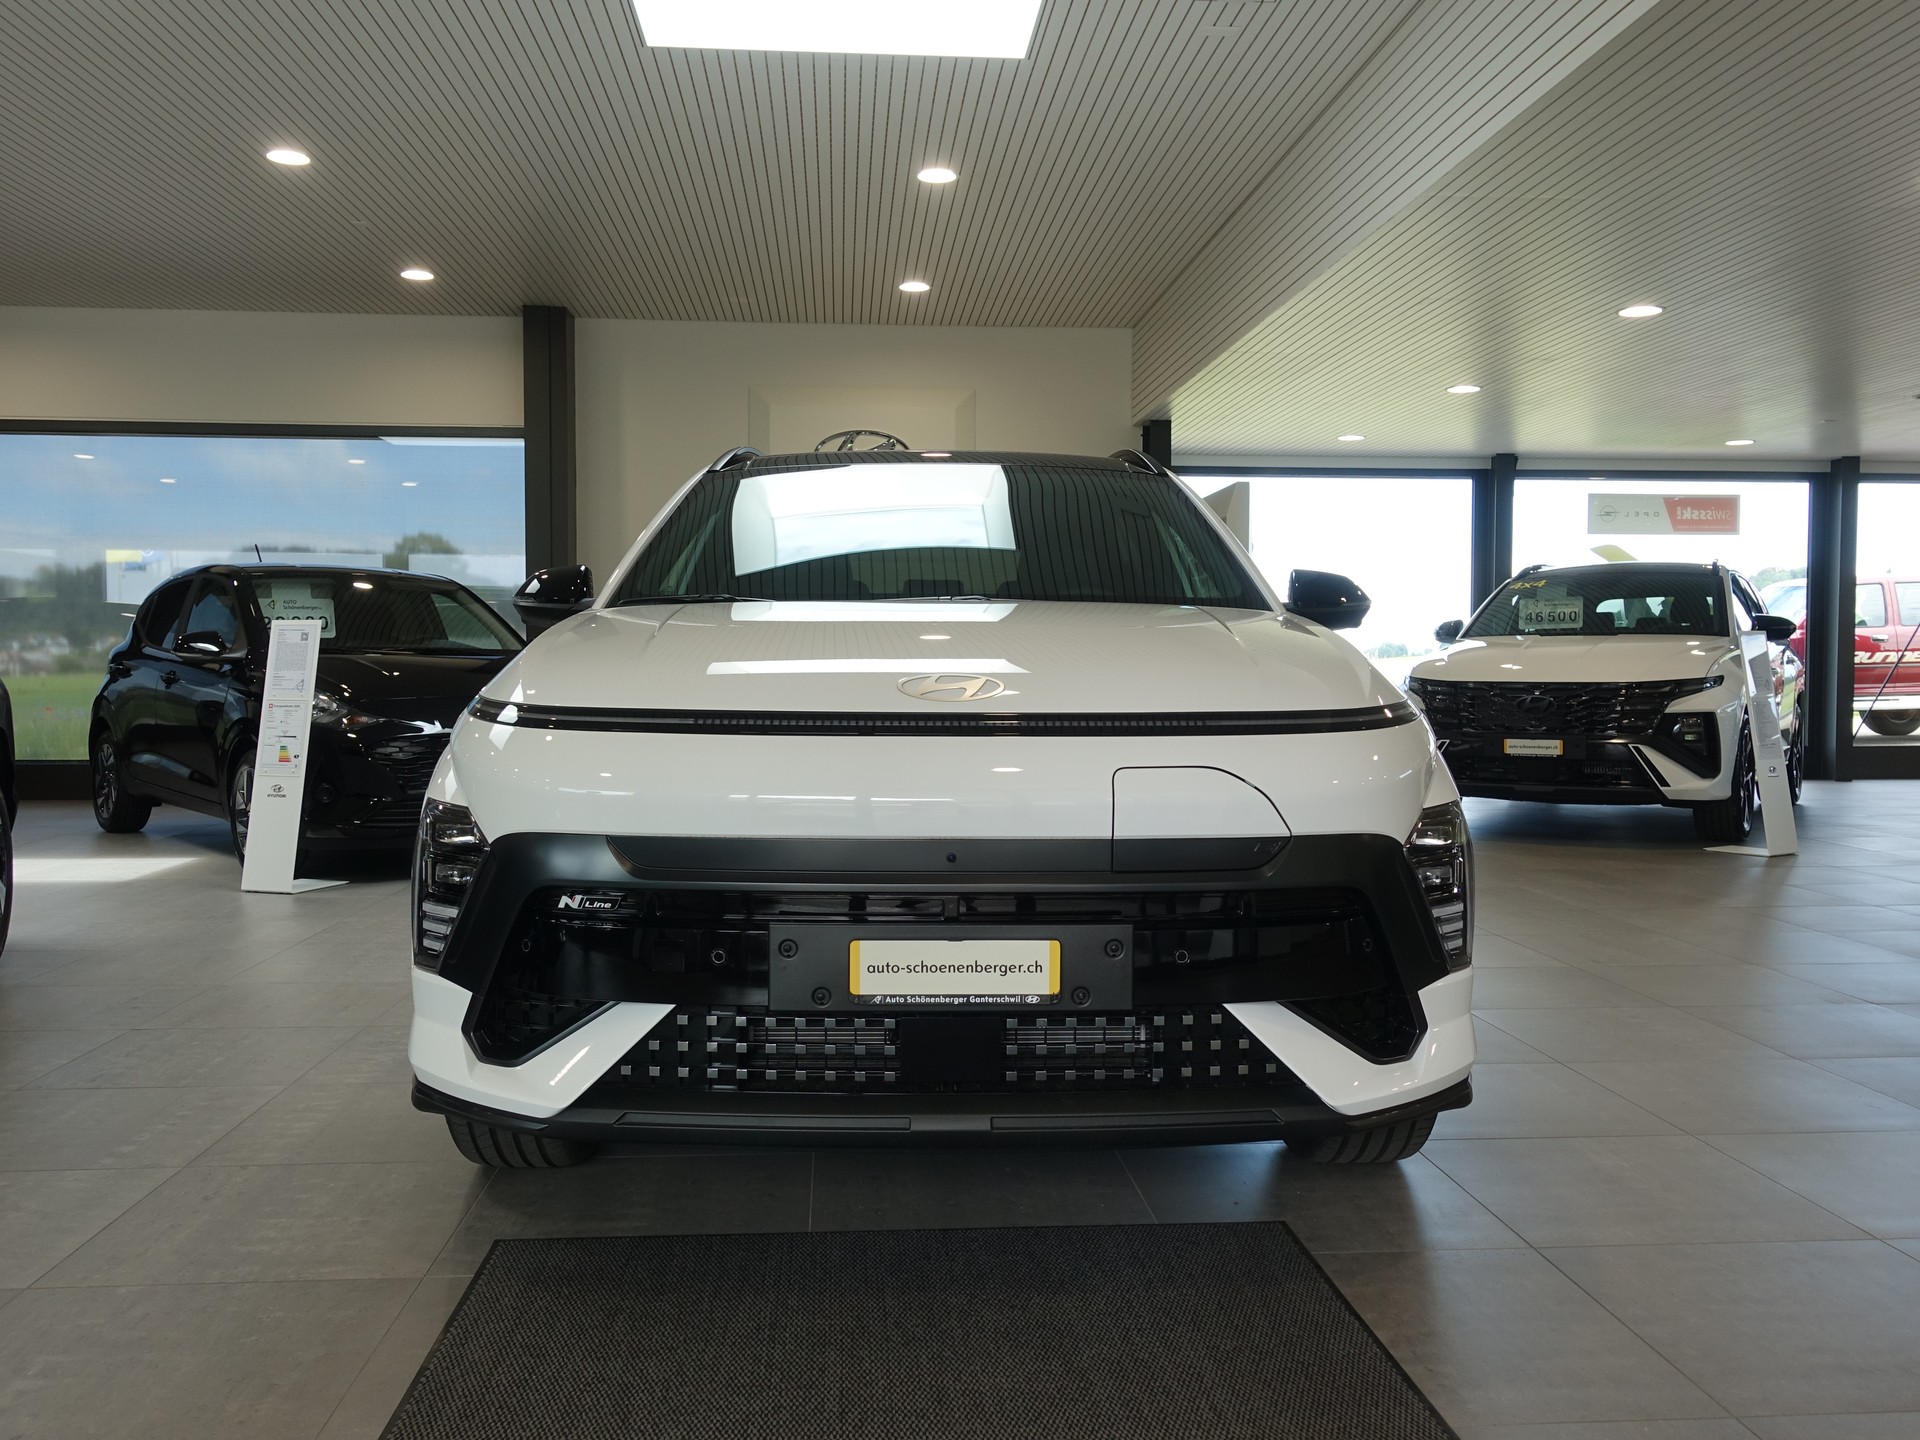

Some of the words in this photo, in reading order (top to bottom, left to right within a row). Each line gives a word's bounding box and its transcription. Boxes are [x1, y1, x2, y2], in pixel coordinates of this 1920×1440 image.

[867, 960, 1043, 977] auto-schoenenberger.ch
[906, 995, 967, 1004] Schönenberger
[969, 995, 1021, 1003] Ganterschwil
